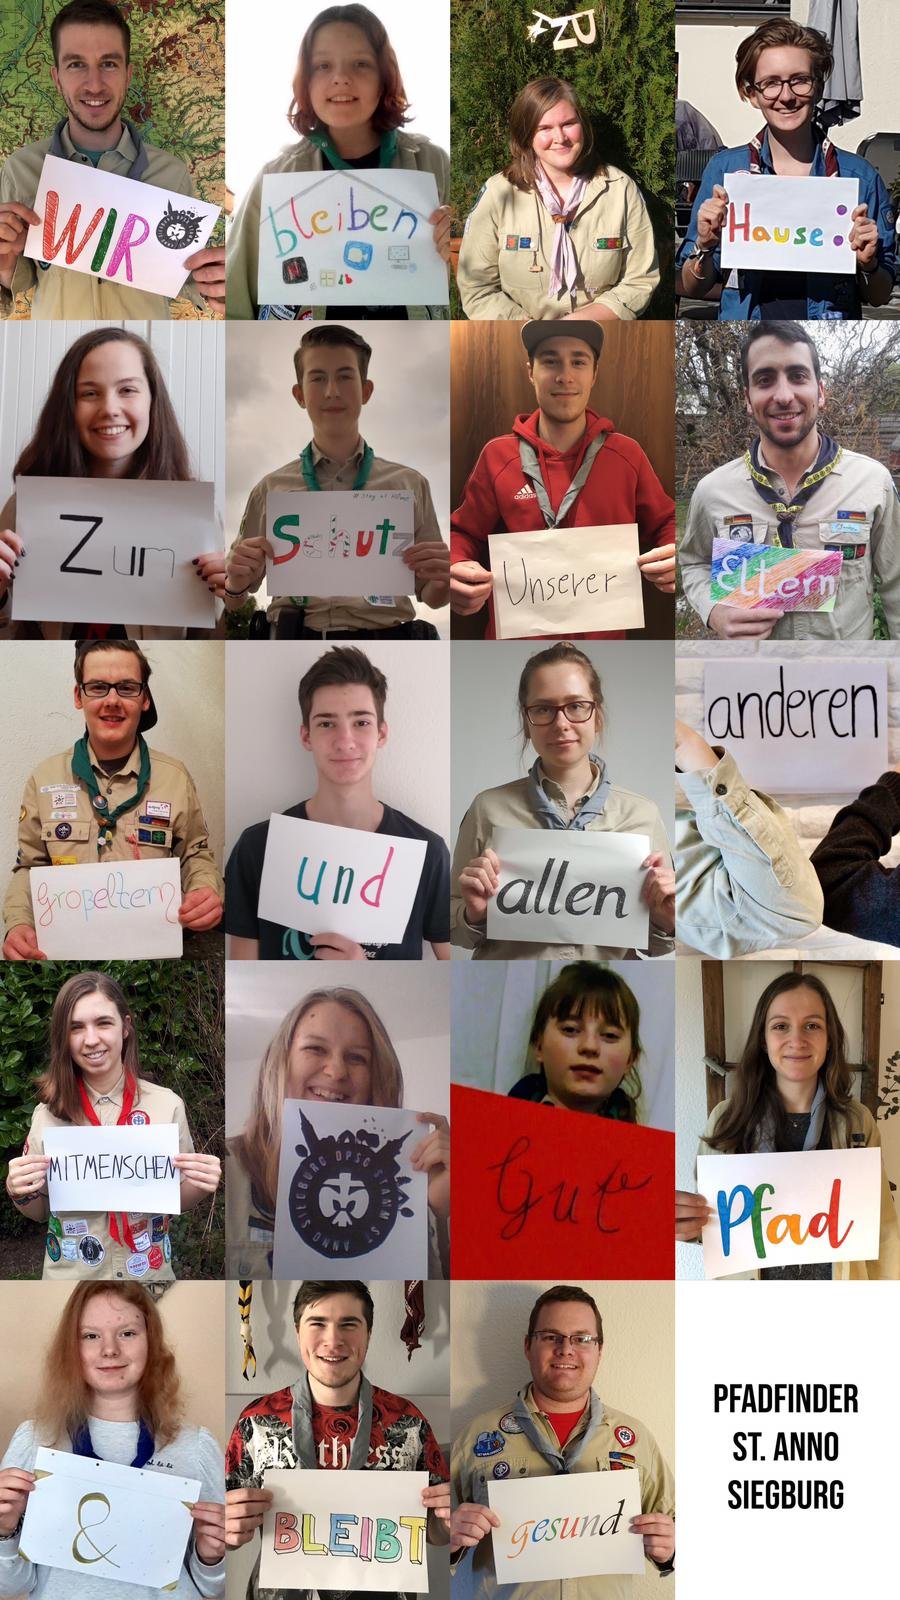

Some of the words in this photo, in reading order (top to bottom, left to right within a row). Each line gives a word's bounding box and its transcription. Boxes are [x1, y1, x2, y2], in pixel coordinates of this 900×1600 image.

[41, 190, 150, 283] WIR
[267, 186, 418, 258] bleiben
[273, 514, 414, 566] Schutz
[502, 557, 618, 606] Unserer
[717, 553, 836, 601] Eltern
[707, 665, 880, 740] anderen
[296, 845, 396, 909] und
[495, 857, 629, 919] allen
[487, 1136, 654, 1241] Gute
[716, 1178, 855, 1259] Pfad
[72, 1491, 120, 1568] &
[273, 1511, 428, 1565] BLEIBT
[506, 1499, 626, 1559] gesund
